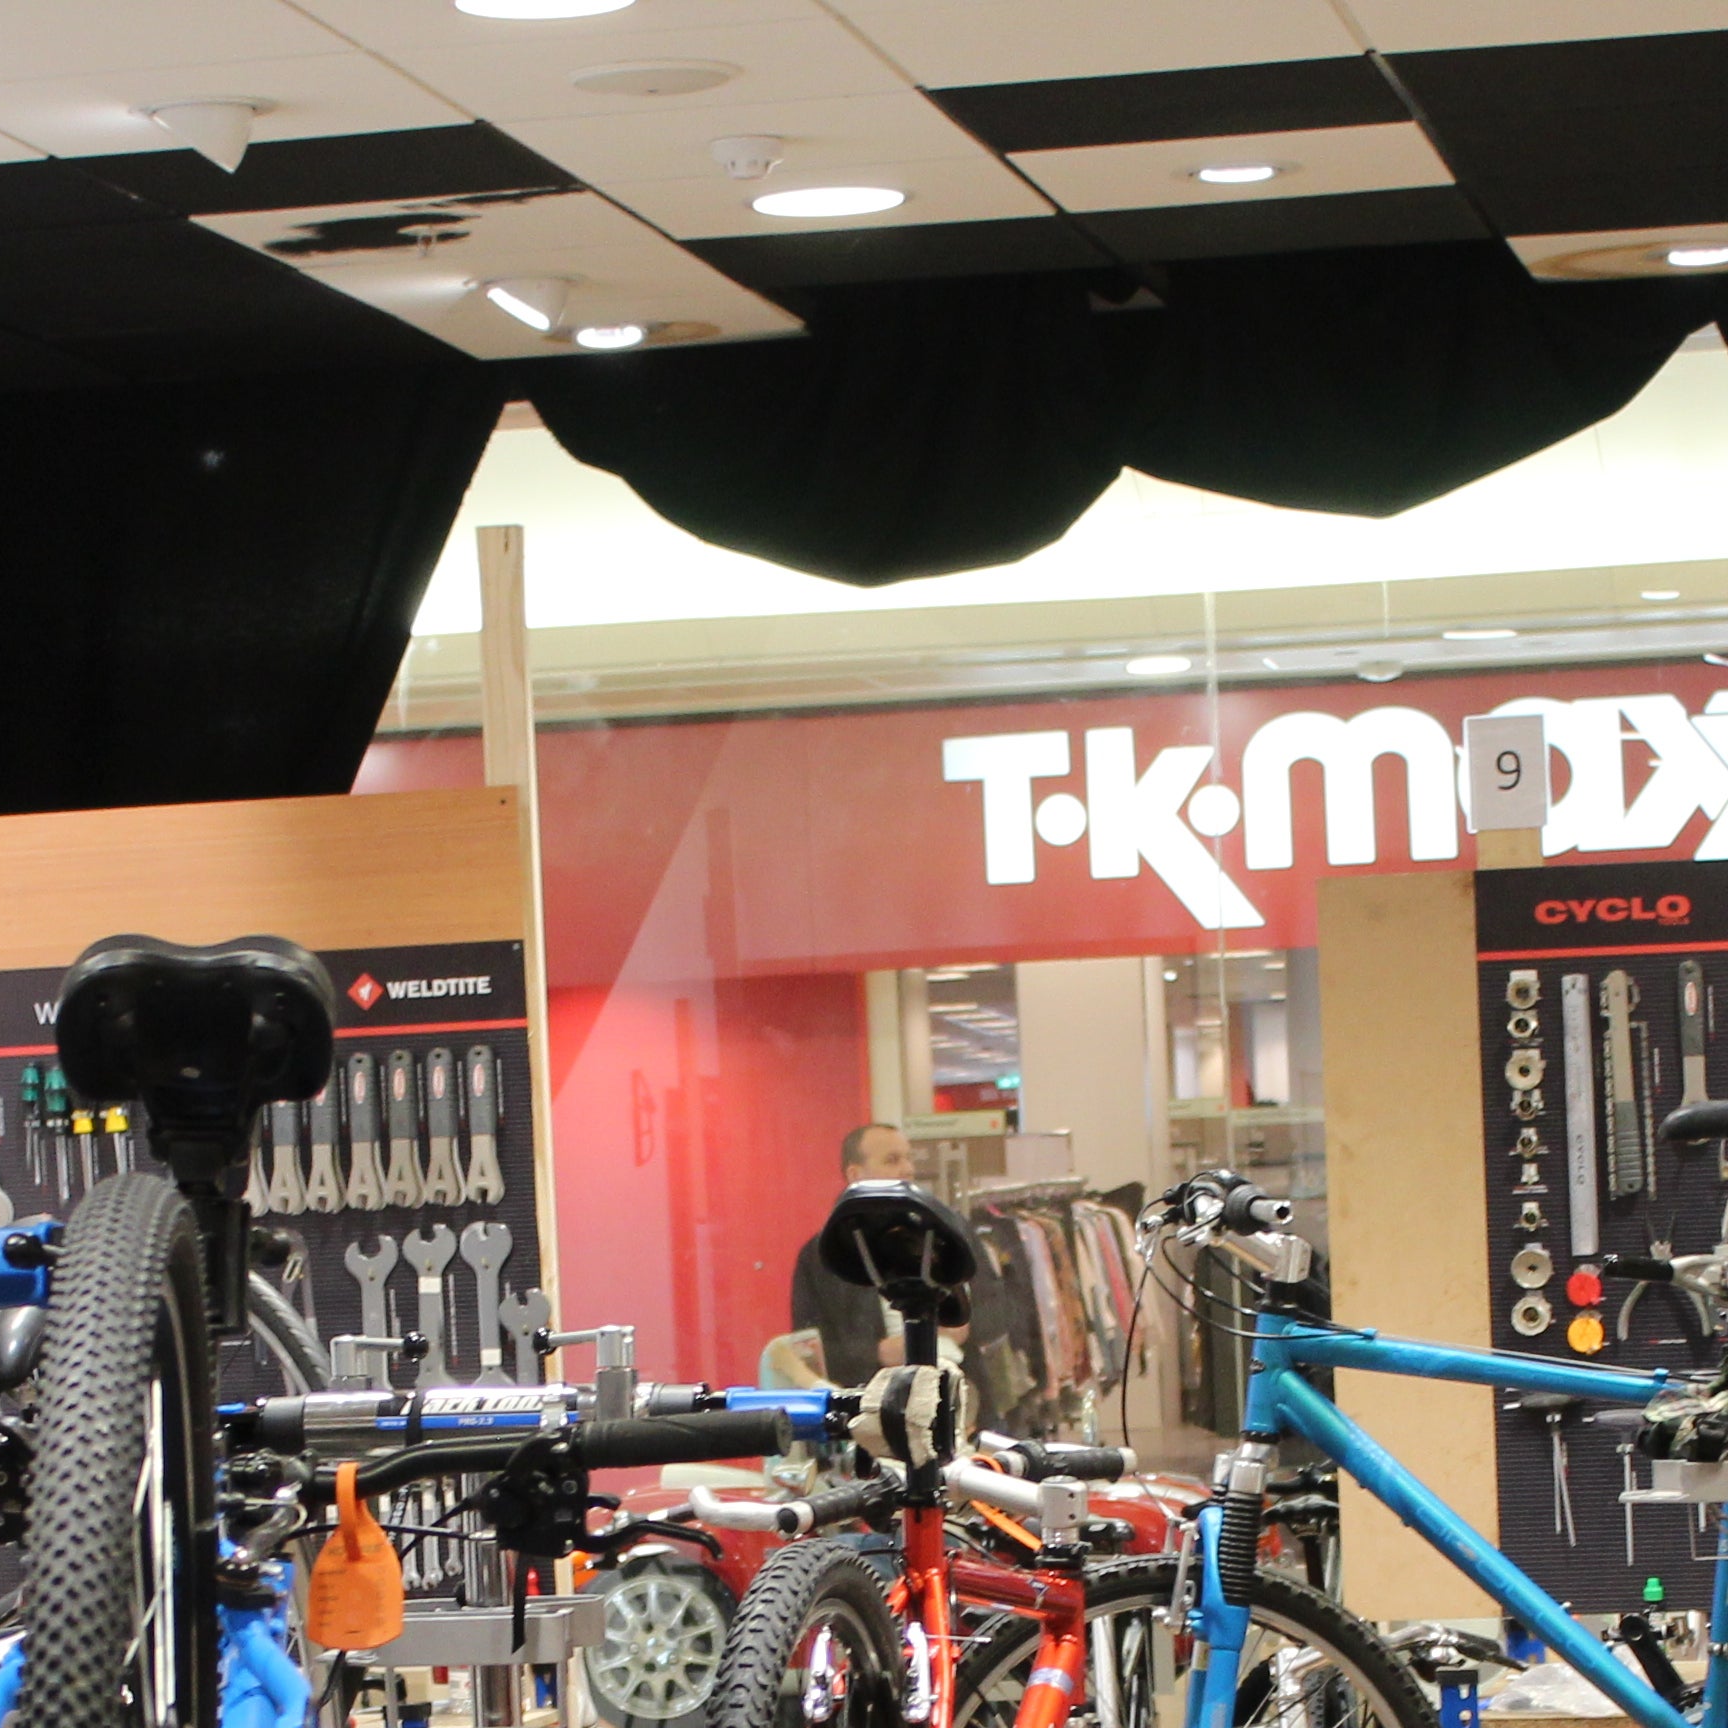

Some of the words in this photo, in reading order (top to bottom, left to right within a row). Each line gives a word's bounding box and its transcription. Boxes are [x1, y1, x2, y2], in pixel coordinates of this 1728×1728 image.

[1496, 750, 1521, 790] 9
[1534, 894, 1692, 925] CYCLO
[385, 976, 492, 1000] WELDTITE
